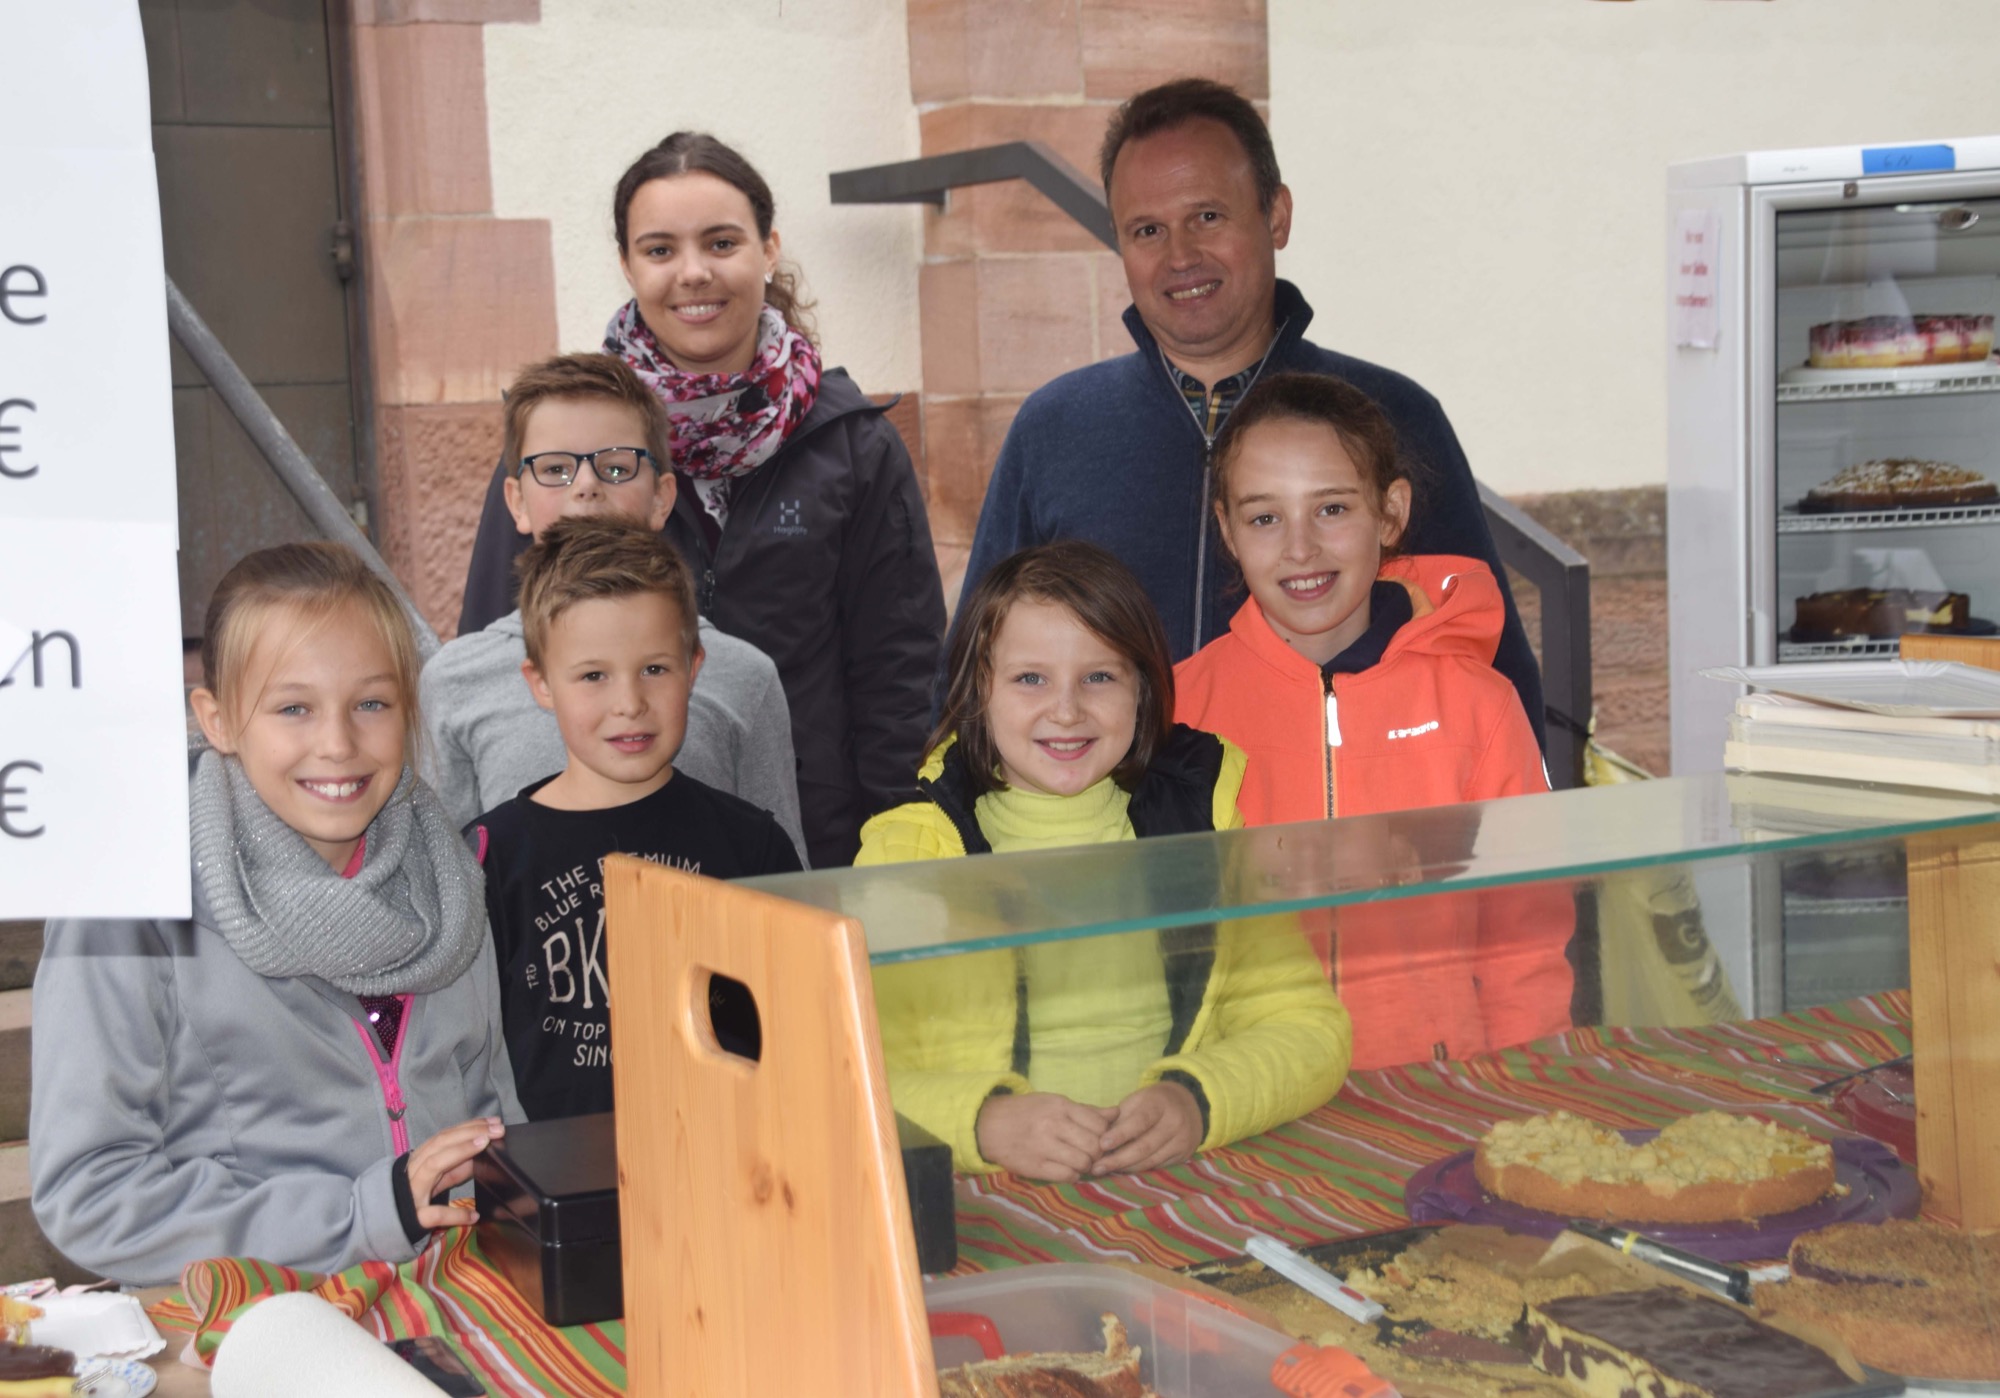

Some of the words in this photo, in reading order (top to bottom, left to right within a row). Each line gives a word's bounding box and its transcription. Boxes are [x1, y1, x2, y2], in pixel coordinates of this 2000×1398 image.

[541, 865, 590, 900] THE
[534, 892, 582, 932] BLUE
[542, 1016, 567, 1035] ON
[573, 1021, 606, 1040] TOP
[573, 1044, 613, 1067] SIN
